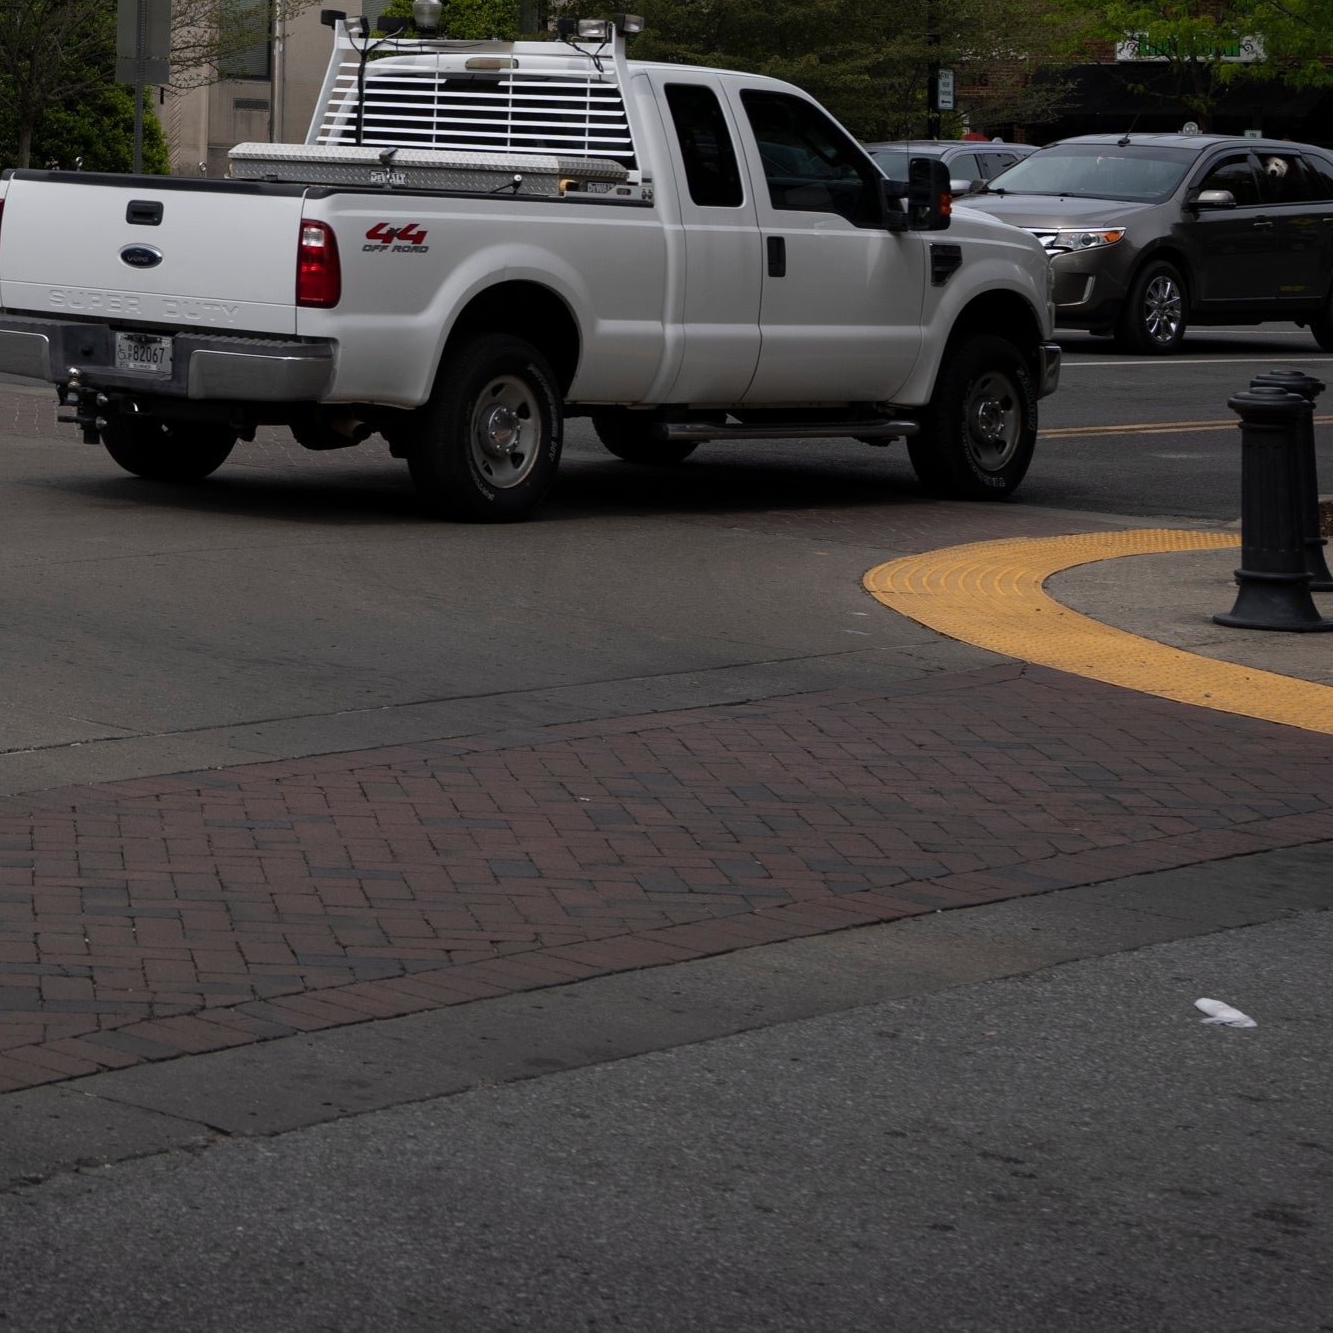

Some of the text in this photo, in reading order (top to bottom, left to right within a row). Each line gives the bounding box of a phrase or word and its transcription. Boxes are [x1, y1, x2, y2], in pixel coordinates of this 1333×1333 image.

[362, 244, 430, 254] OFF ROAD
[48, 289, 240, 324] SUPER DUTY
[133, 345, 165, 364] 82067
